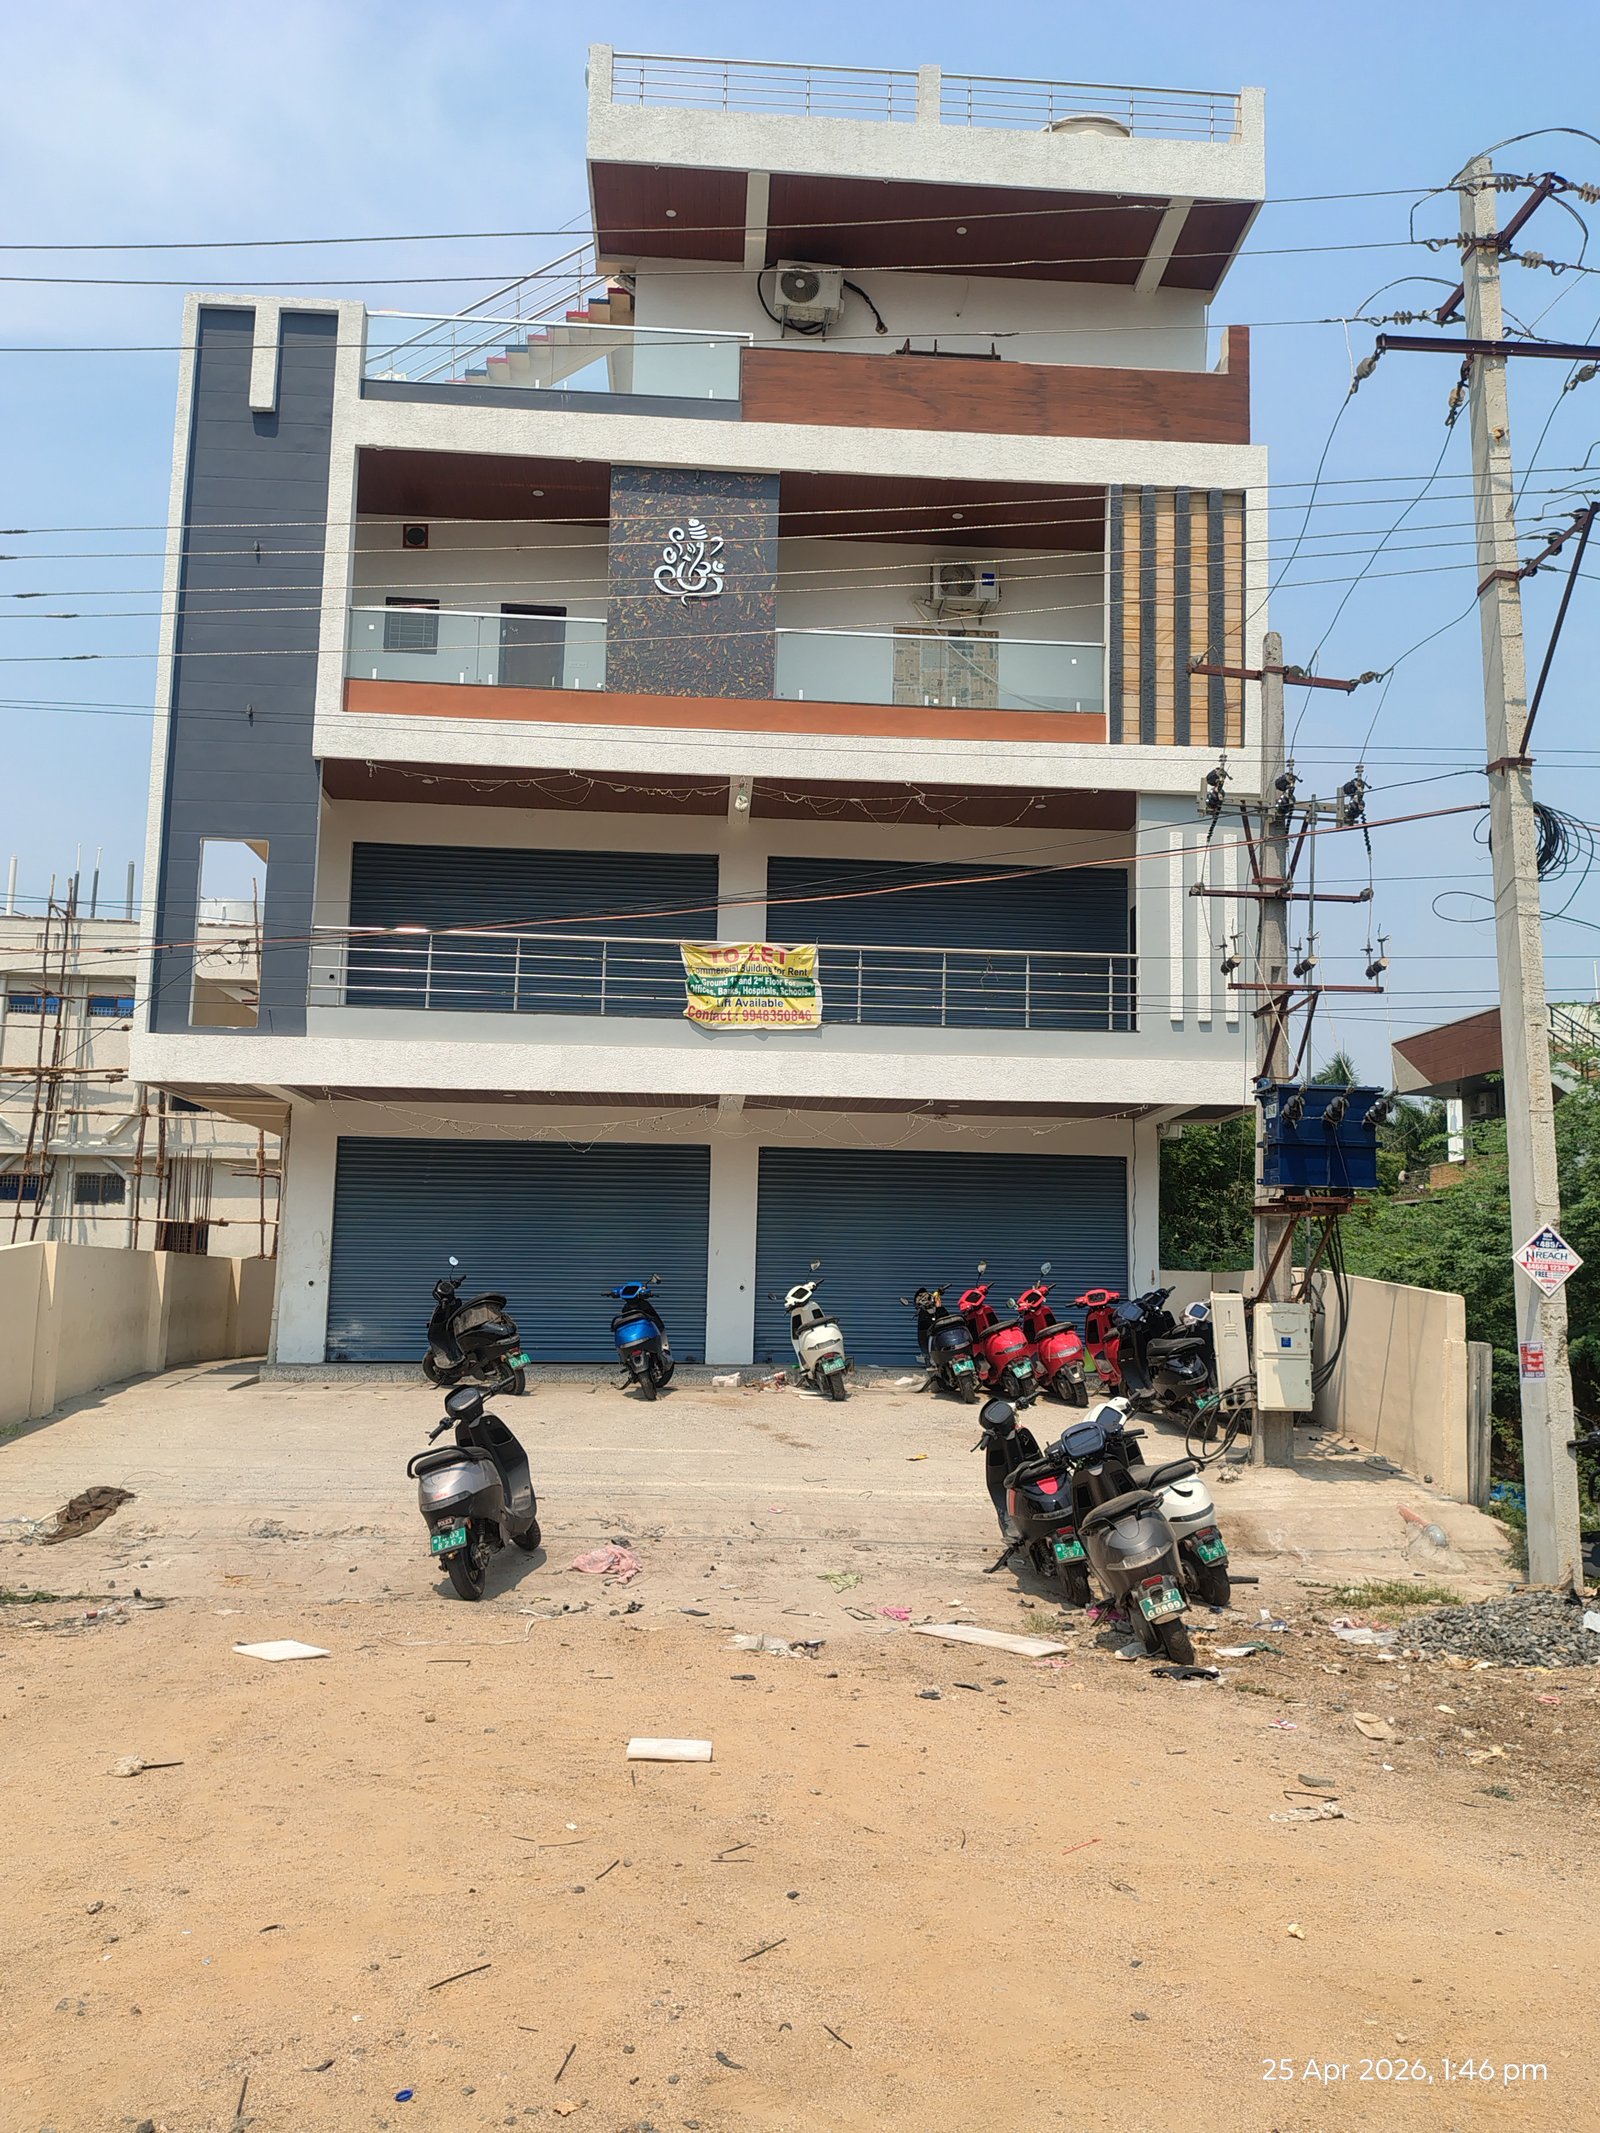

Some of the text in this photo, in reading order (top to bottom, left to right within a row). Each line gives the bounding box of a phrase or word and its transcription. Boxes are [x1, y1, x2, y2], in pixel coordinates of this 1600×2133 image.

[694, 964, 739, 976] ommercial
[740, 963, 773, 976] Building
[787, 967, 808, 977] Rent
[702, 977, 728, 987] Ground
[739, 977, 752, 986] and
[765, 977, 782, 986] Floor
[784, 978, 796, 987] For
[717, 998, 784, 1008] Lift Available
[688, 1005, 732, 1022] Contact
[742, 1010, 812, 1022] 9948350846
